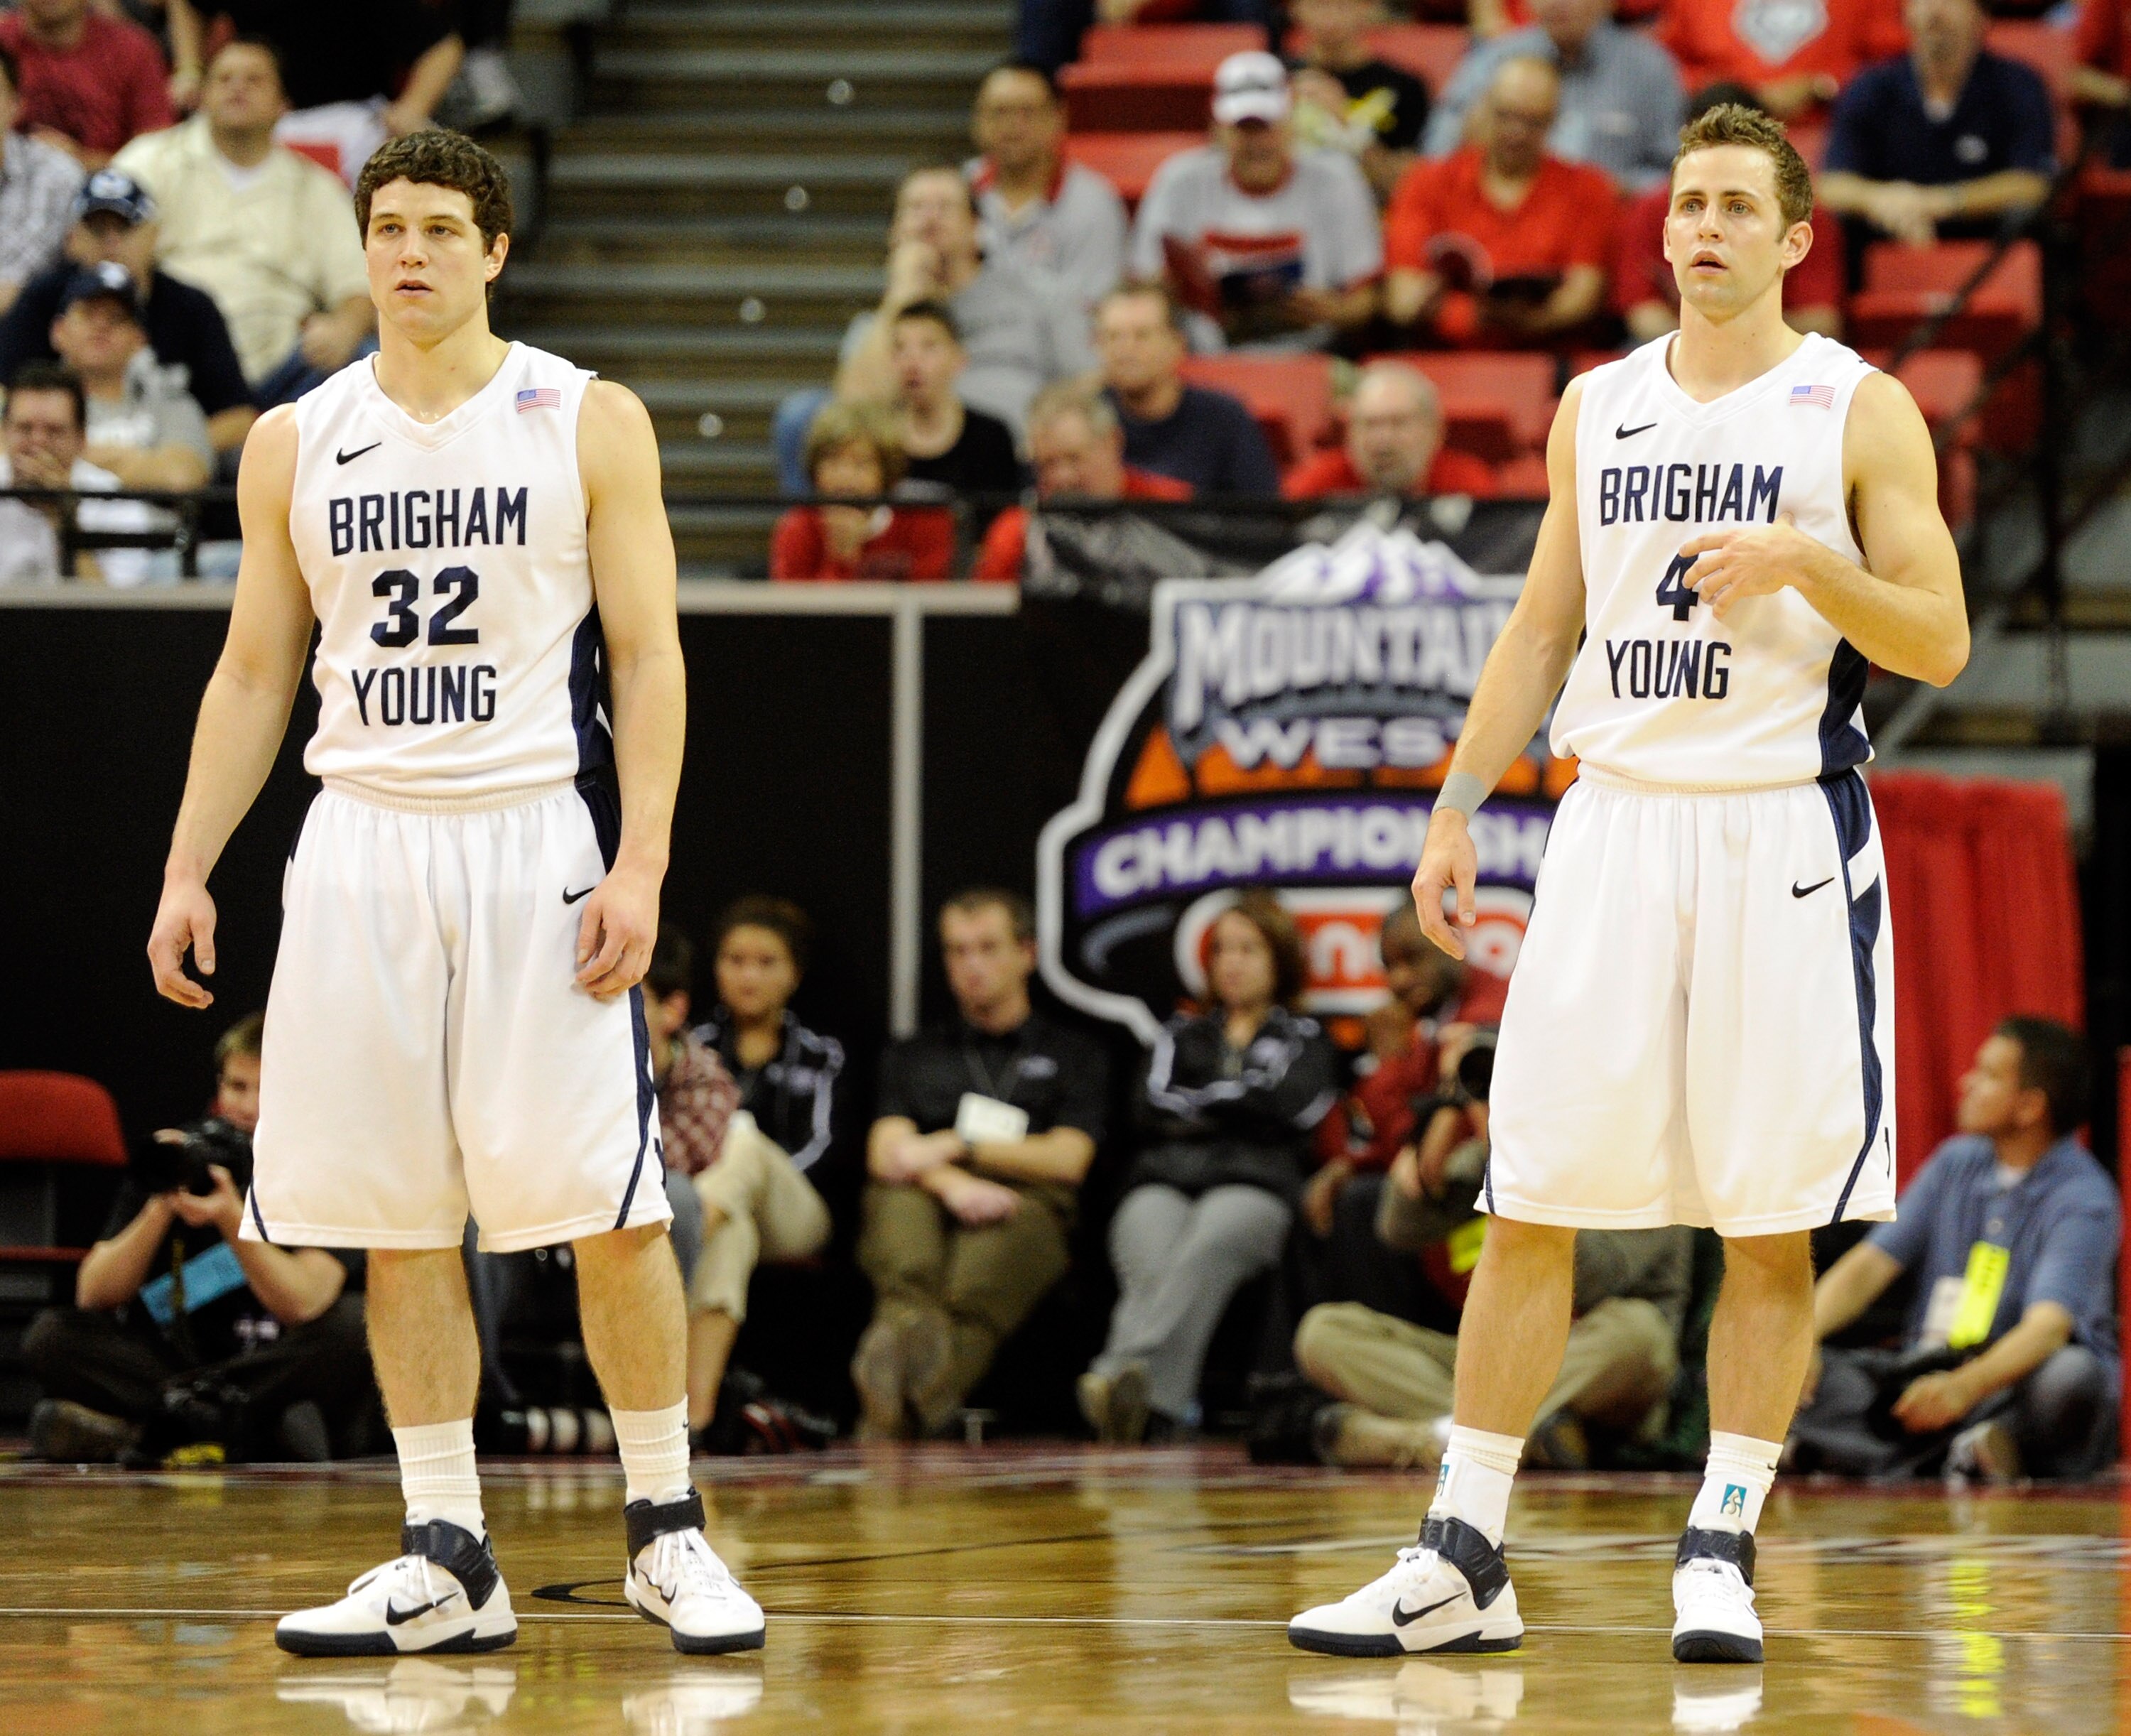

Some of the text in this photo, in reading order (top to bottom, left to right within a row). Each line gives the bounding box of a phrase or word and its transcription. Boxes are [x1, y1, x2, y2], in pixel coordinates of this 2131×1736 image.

[329, 487, 528, 557] BRIGHAM
[1600, 462, 1784, 526] BRIGHAM
[369, 565, 479, 649] 32
[1655, 551, 1701, 622] 4
[351, 664, 497, 727] YOUNG
[1605, 639, 1733, 700] YOUNG
[1215, 715, 1465, 770] WES
